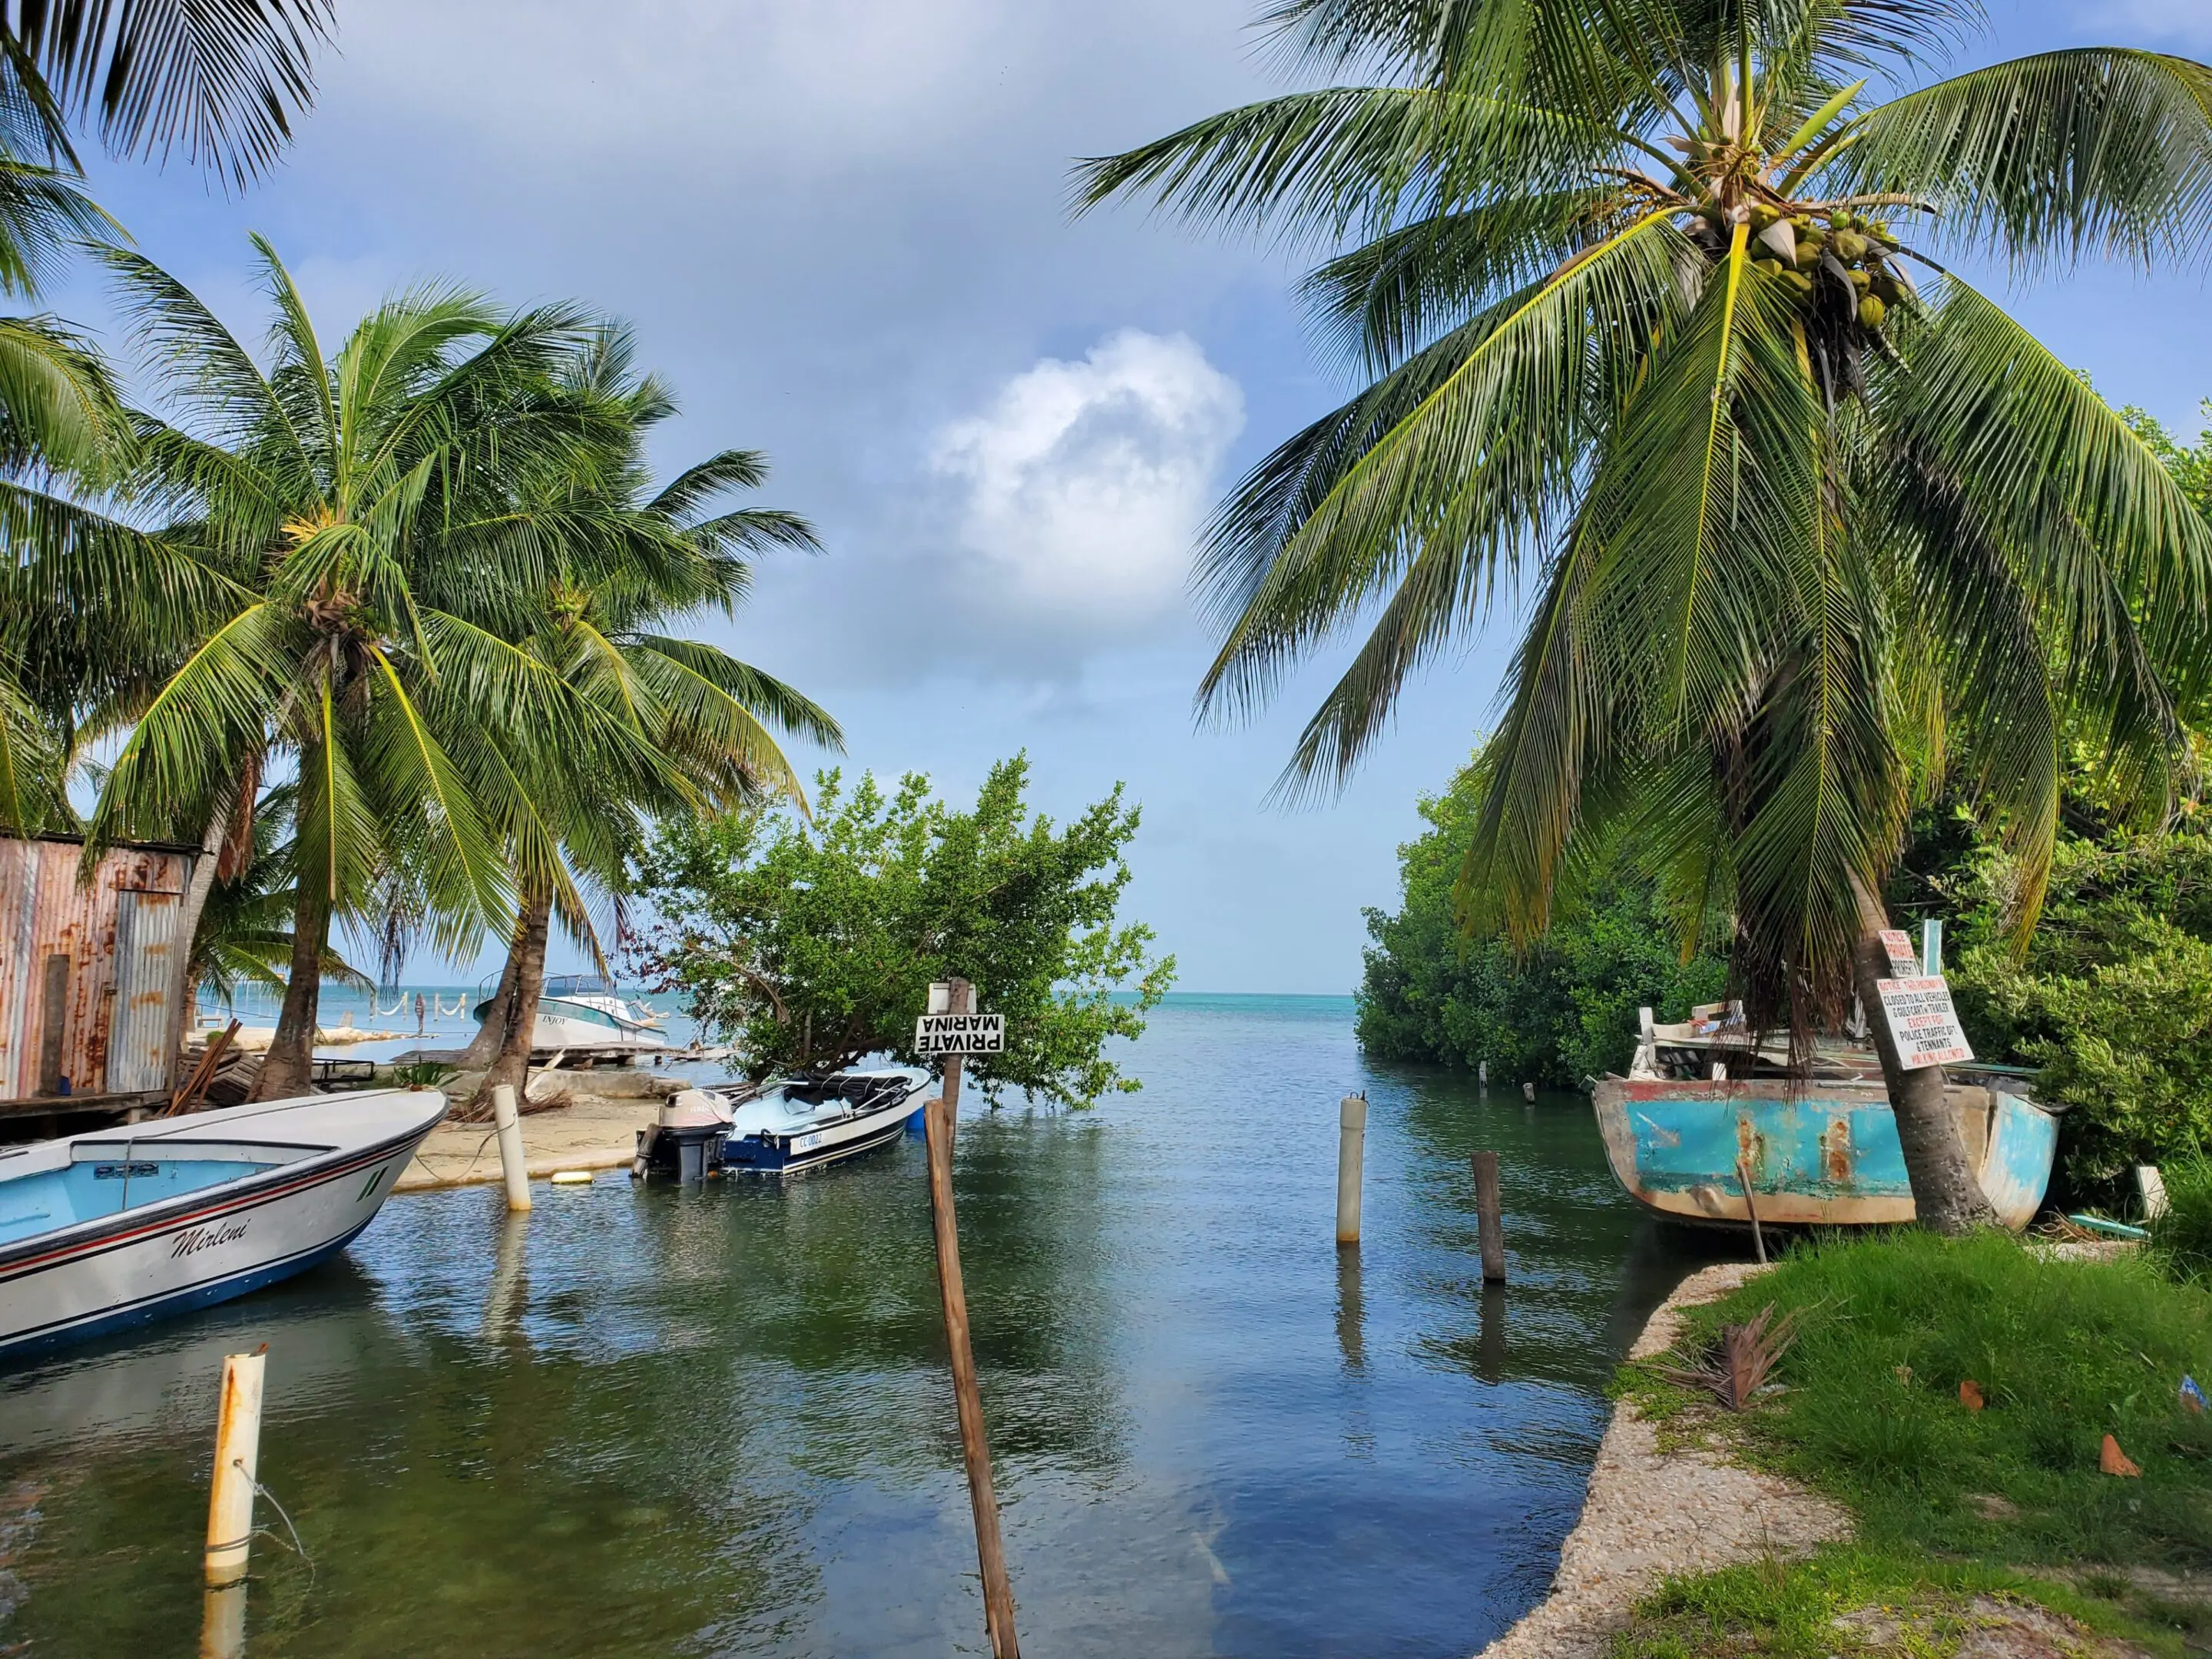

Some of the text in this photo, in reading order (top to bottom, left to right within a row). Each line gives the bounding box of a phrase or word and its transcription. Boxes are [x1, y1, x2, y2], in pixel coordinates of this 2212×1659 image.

[1883, 991, 1951, 1006] CLOSED TO ALL VEHICLES
[1928, 1002, 1949, 1014] TRAILER
[922, 1016, 999, 1032] MARINA
[1907, 1014, 1944, 1028] EXCEPT FOR
[1899, 1029, 1923, 1041] POLICE
[1922, 1026, 1947, 1038] TRAFFIC
[918, 1034, 1001, 1052] PRIVATE
[1920, 1038, 1952, 1051] TENNANTS
[1911, 1048, 1965, 1065] WALKING ALLOWED
[171, 1218, 251, 1259] Mirleni
